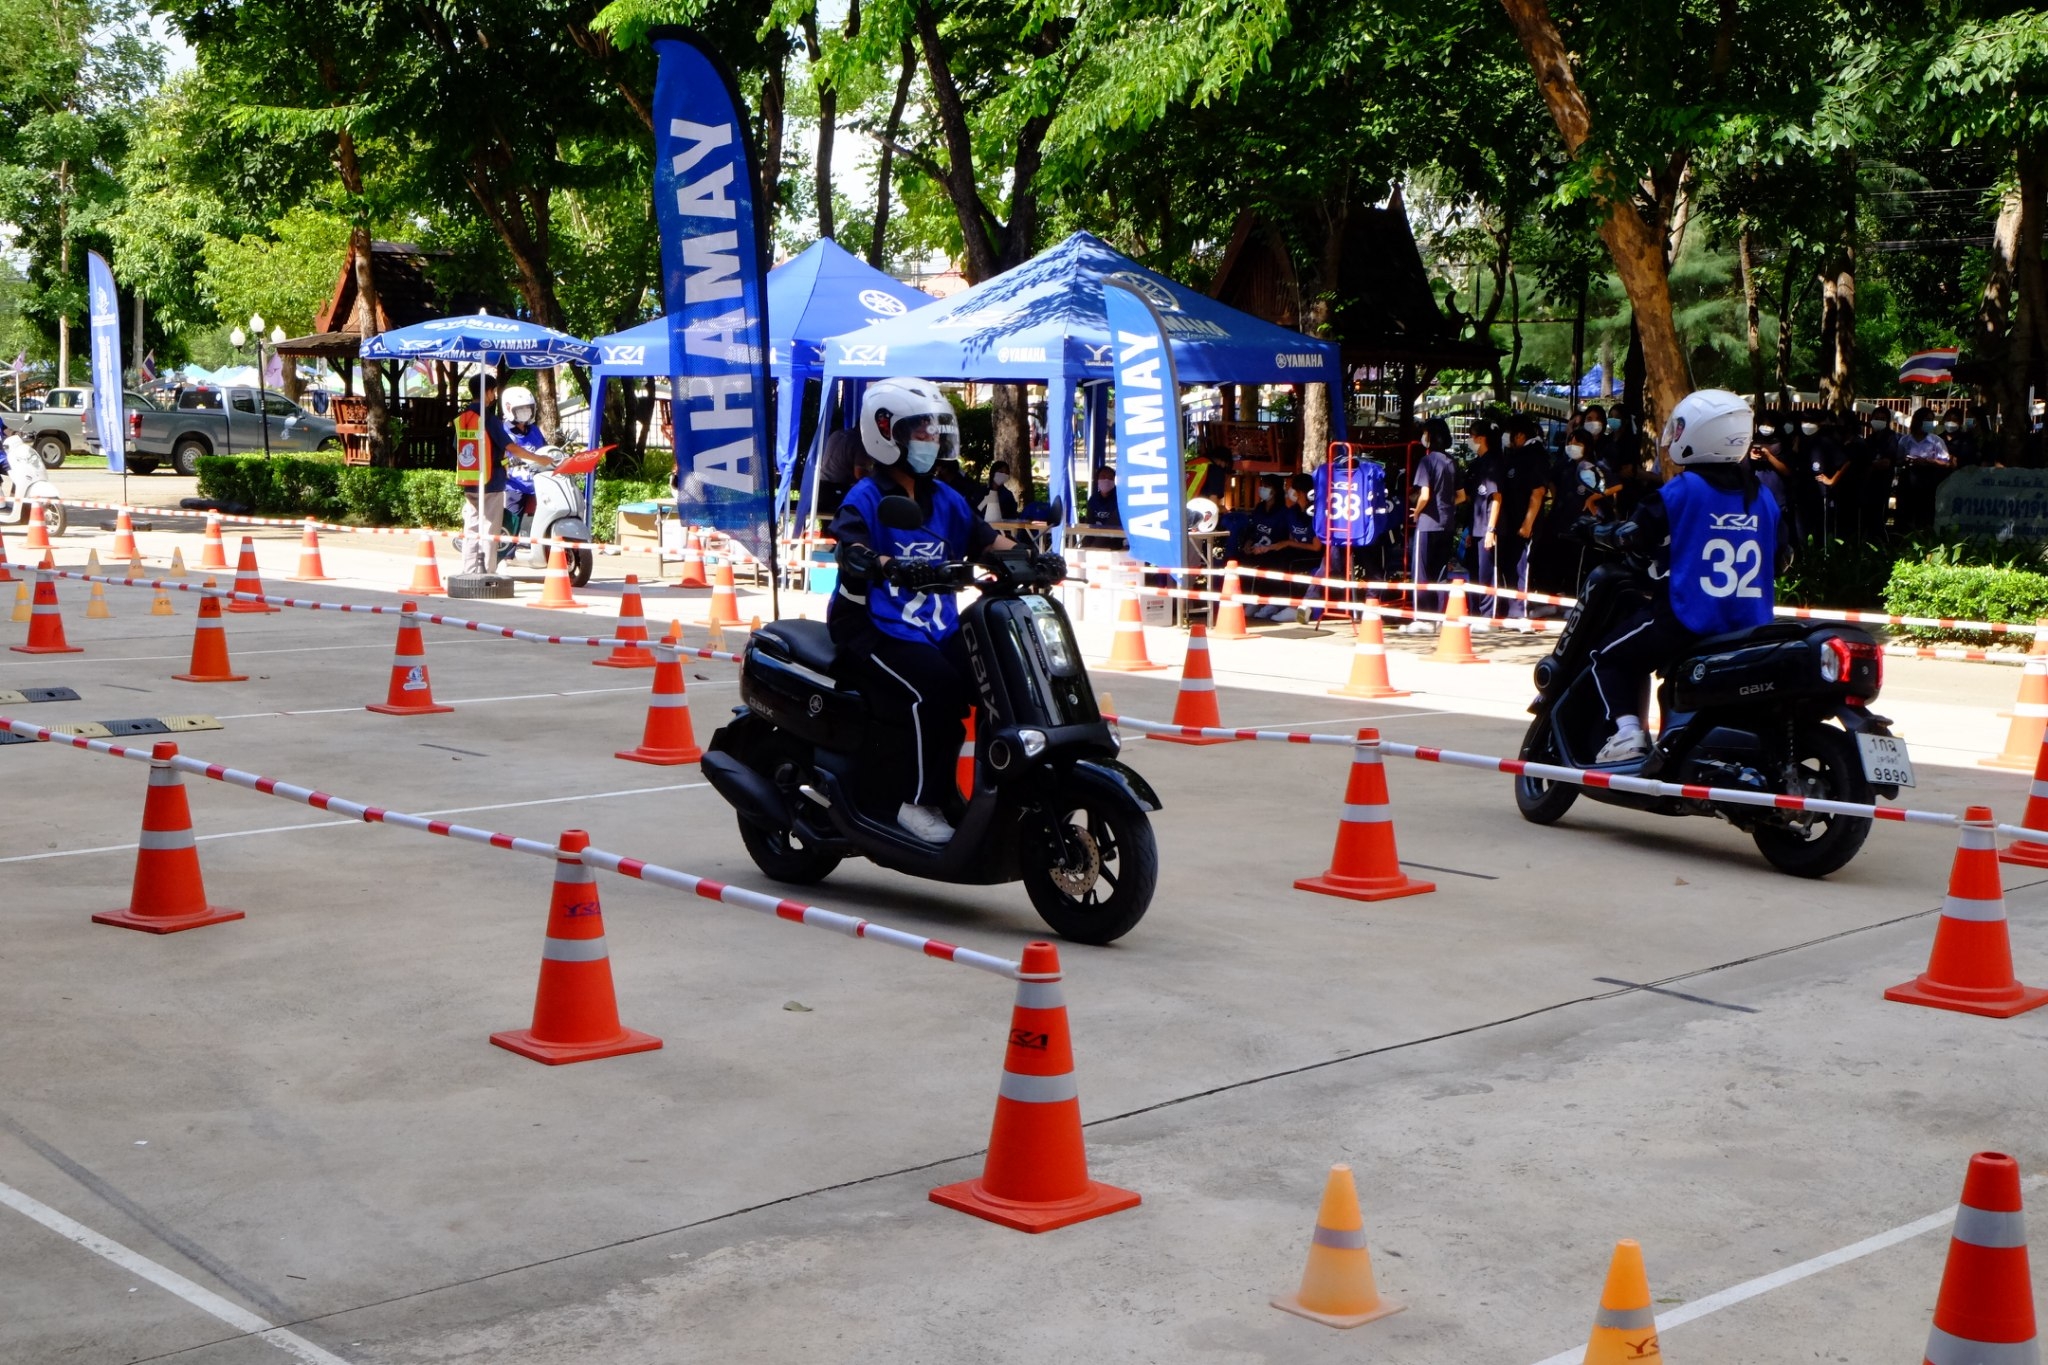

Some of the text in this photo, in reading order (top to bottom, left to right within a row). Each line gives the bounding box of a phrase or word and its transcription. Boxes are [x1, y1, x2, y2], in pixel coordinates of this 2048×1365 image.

[492, 339, 538, 350] YAMAHA
[604, 345, 645, 360] YRA
[839, 345, 888, 361] YRA
[1009, 347, 1046, 362] YAMAHA
[1286, 353, 1323, 368] YAMAHA
[1326, 492, 1360, 521] 38
[1710, 513, 1758, 527] YRA
[894, 541, 945, 556] YRA
[1700, 538, 1762, 597] 32
[962, 621, 1000, 725] QBIX
[1739, 682, 1775, 696] QBIX
[1873, 767, 1908, 784] 9890
